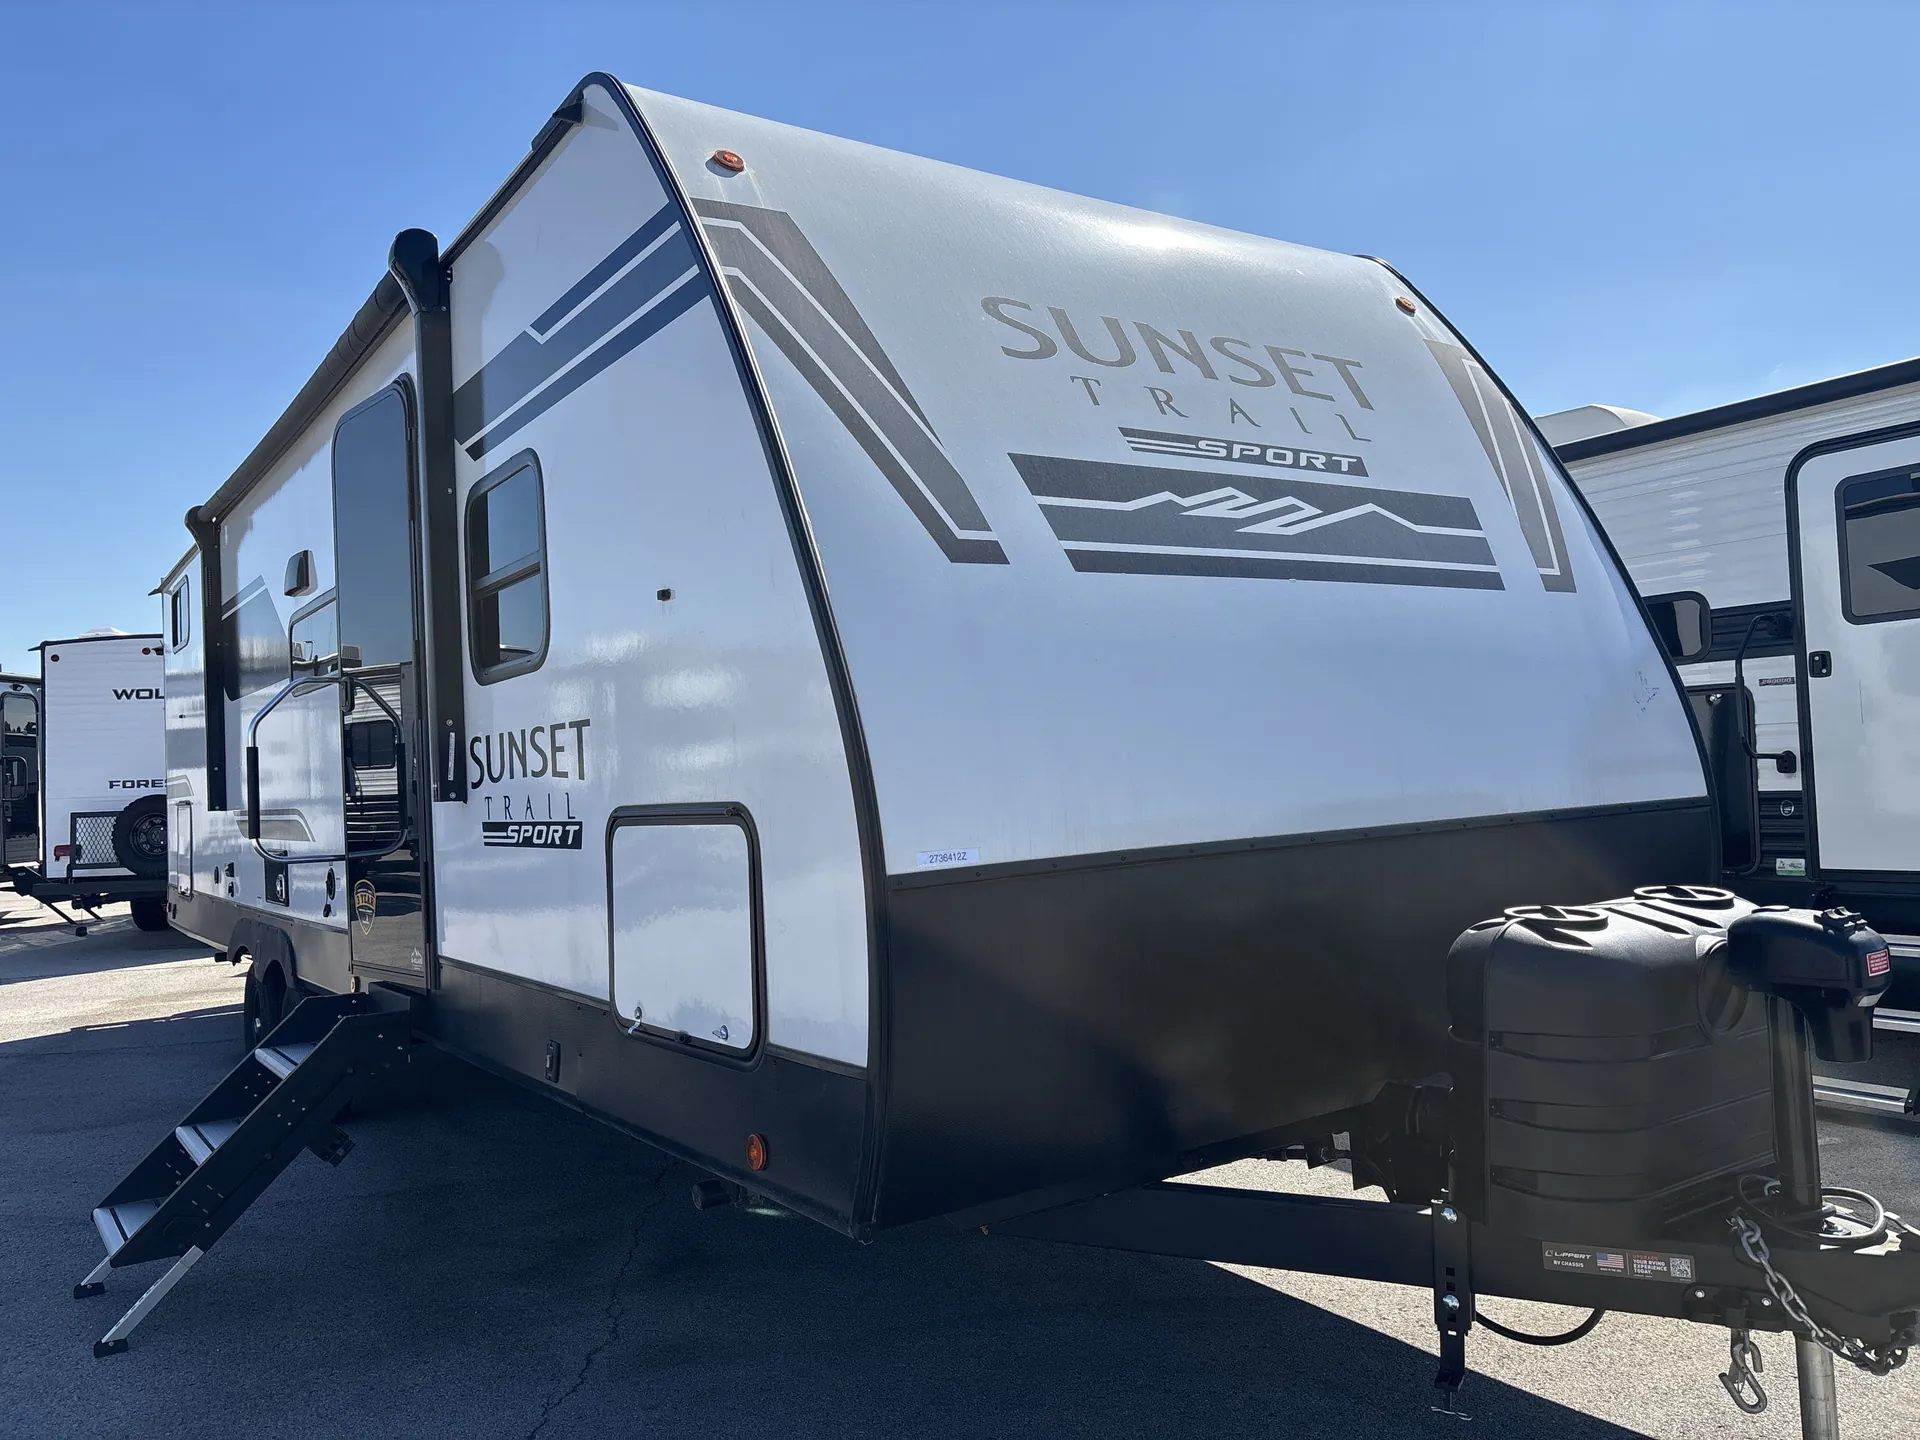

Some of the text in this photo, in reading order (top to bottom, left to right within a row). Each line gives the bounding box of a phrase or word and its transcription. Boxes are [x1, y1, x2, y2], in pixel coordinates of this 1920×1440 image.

[981, 296, 1375, 411] SUNSET
[1070, 375, 1372, 443] TRAIL
[1196, 440, 1358, 473] SPORT
[470, 718, 591, 790] SUNSET
[108, 779, 167, 789] FORE
[484, 792, 576, 820] TRAIL
[506, 825, 580, 845] SPORT
[1561, 1260, 1584, 1268] CHASSIS
[1633, 1264, 1668, 1272] EXPERIENCE
